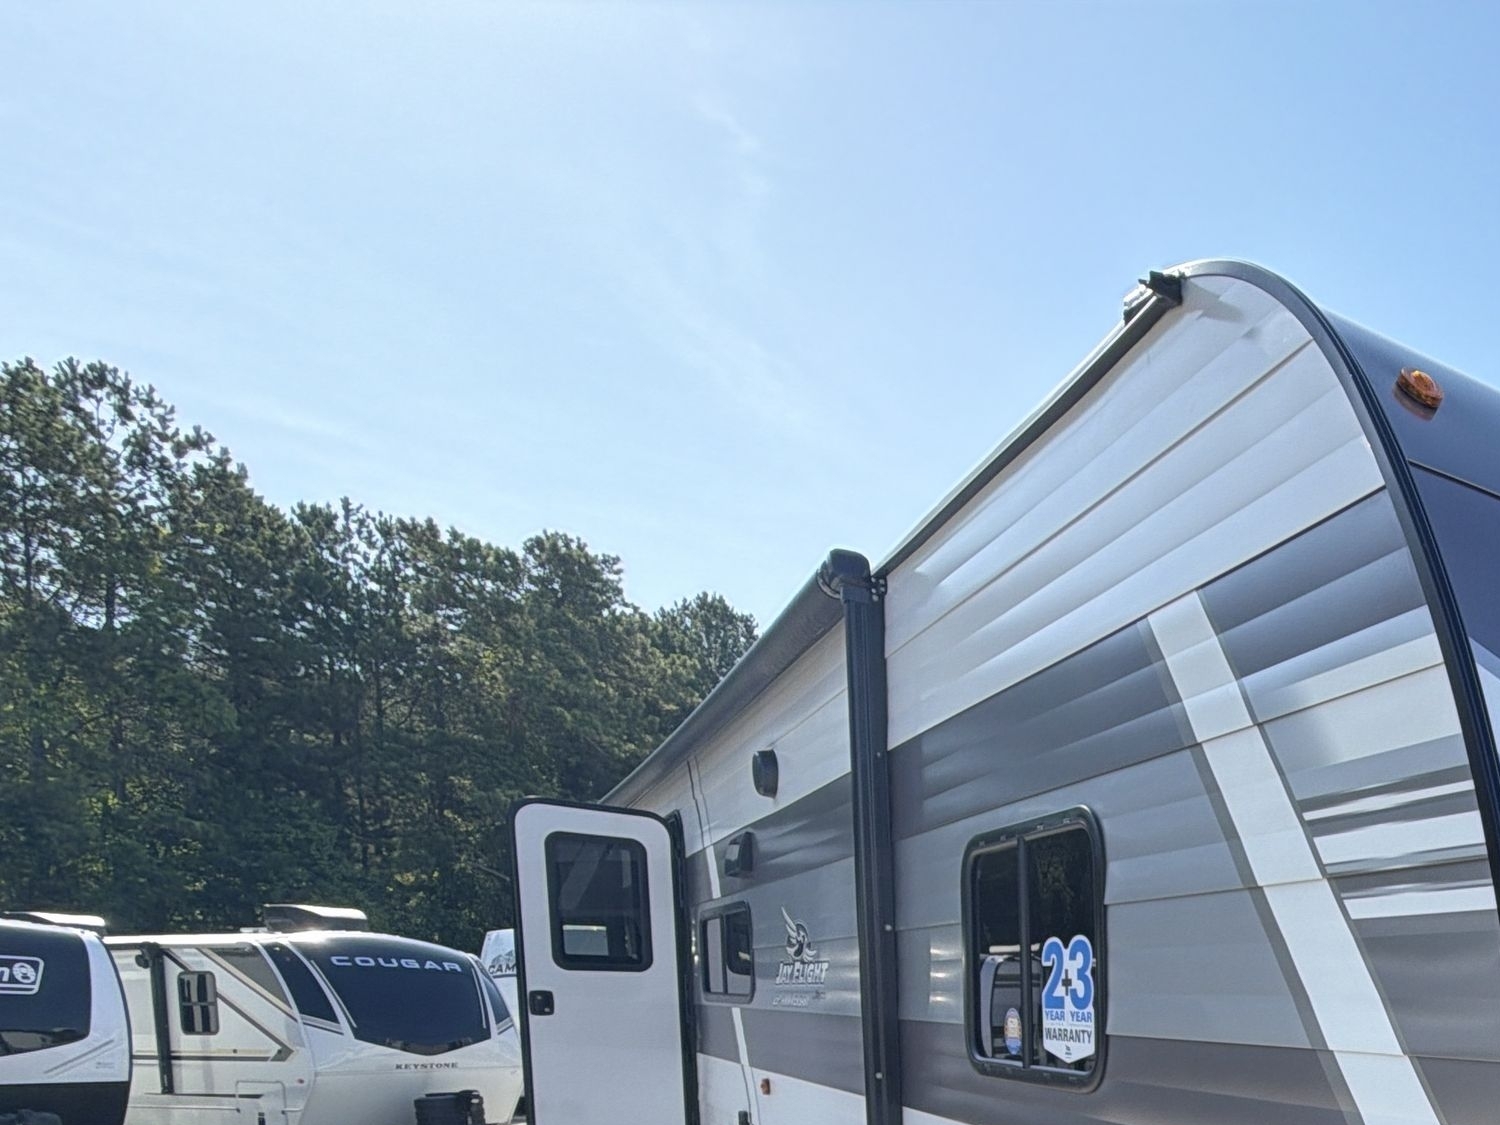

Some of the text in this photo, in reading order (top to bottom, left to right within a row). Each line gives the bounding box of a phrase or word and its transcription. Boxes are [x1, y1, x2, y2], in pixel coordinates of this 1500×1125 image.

[330, 956, 462, 972] COUGAR
[488, 963, 516, 975] CAM
[775, 961, 829, 985] JAY FLIGHT
[1045, 1010, 1092, 1023] YEAR YEAR
[1045, 1027, 1092, 1044] WARRANTY
[395, 1062, 459, 1070] KEYSTONE
